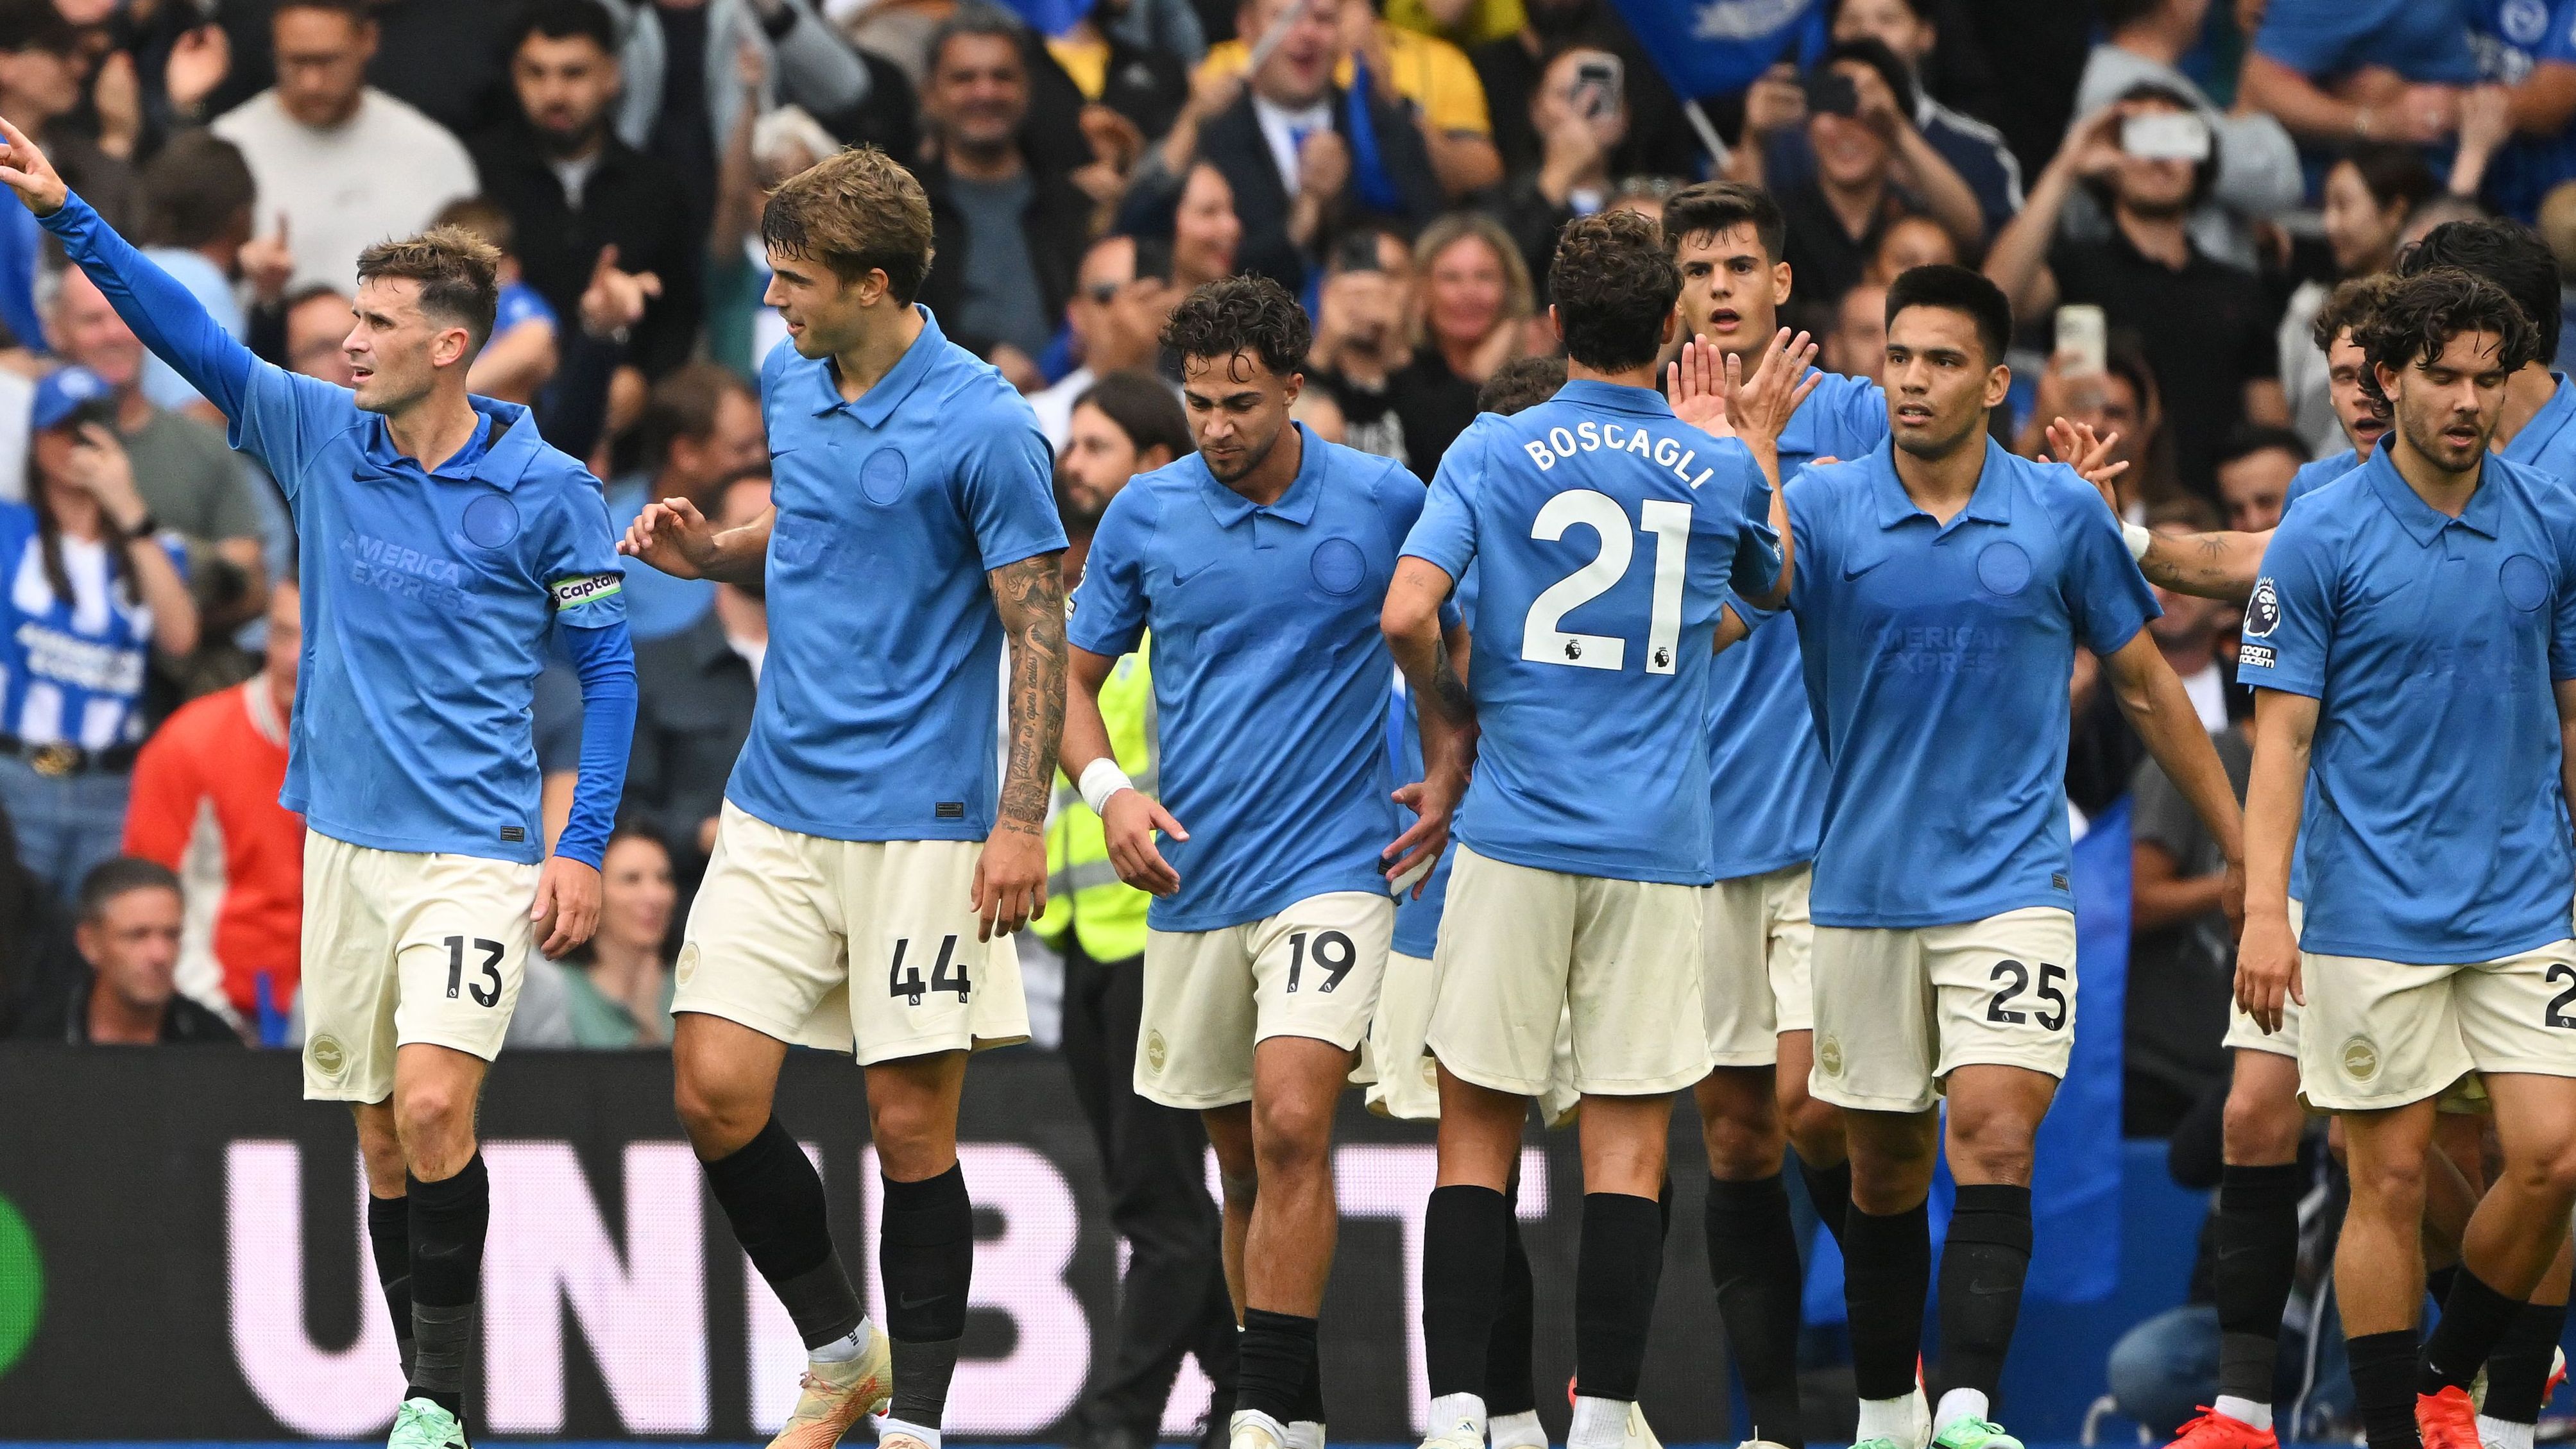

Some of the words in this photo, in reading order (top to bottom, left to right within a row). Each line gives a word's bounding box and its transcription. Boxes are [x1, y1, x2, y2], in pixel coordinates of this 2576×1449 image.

[1524, 421, 1714, 489] BOSCAGLI
[1521, 488, 1693, 675] 21
[2239, 654, 2274, 668] racism
[444, 935, 504, 1008] 13
[890, 935, 971, 1006] 44
[1286, 930, 1356, 994] 19
[1986, 959, 2067, 1031] 25
[222, 1138, 1550, 1442] UNBT
